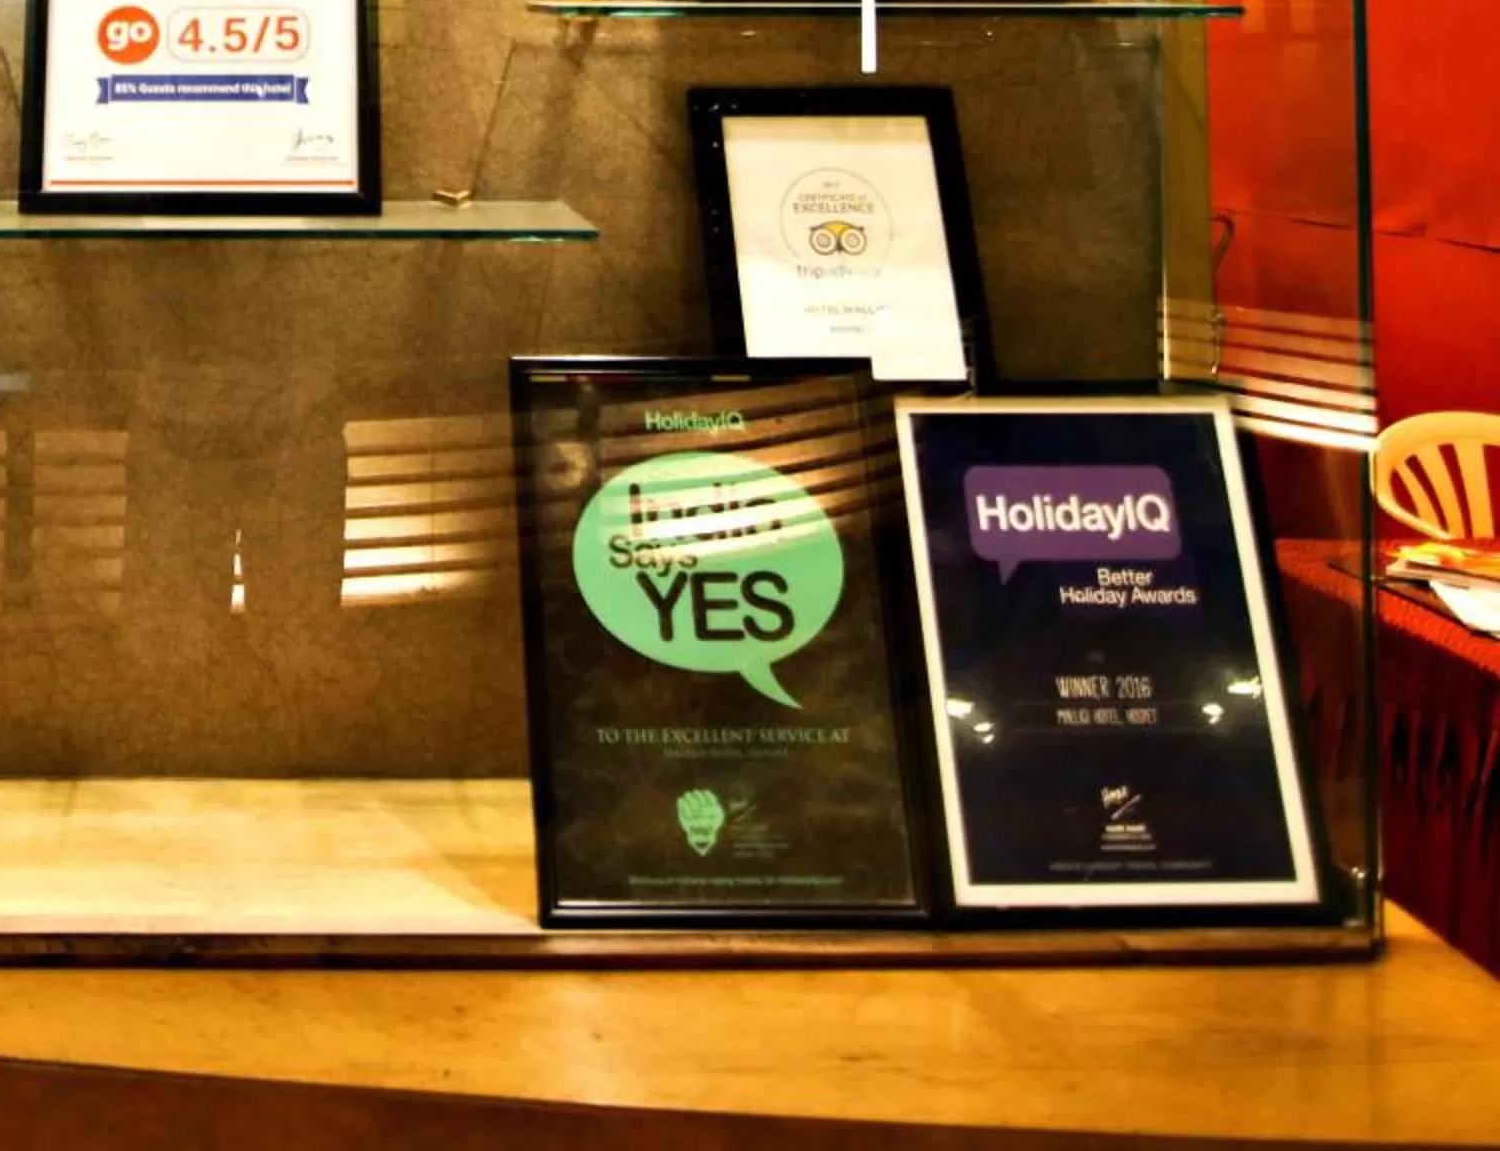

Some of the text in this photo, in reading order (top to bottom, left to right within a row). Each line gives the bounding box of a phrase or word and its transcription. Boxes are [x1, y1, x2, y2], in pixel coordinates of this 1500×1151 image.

[106, 20, 152, 49] go
[177, 16, 301, 53] 4.5/5
[644, 411, 746, 436] HolidayIQ
[975, 493, 1171, 541] HolidayIQ
[1096, 567, 1154, 586] Better
[635, 570, 796, 643] YES
[1059, 586, 1198, 609] Holiday Awards
[1055, 675, 1154, 700] WINNER 2016
[596, 728, 852, 744] TO THE EXCELLENT SERVICE AT
